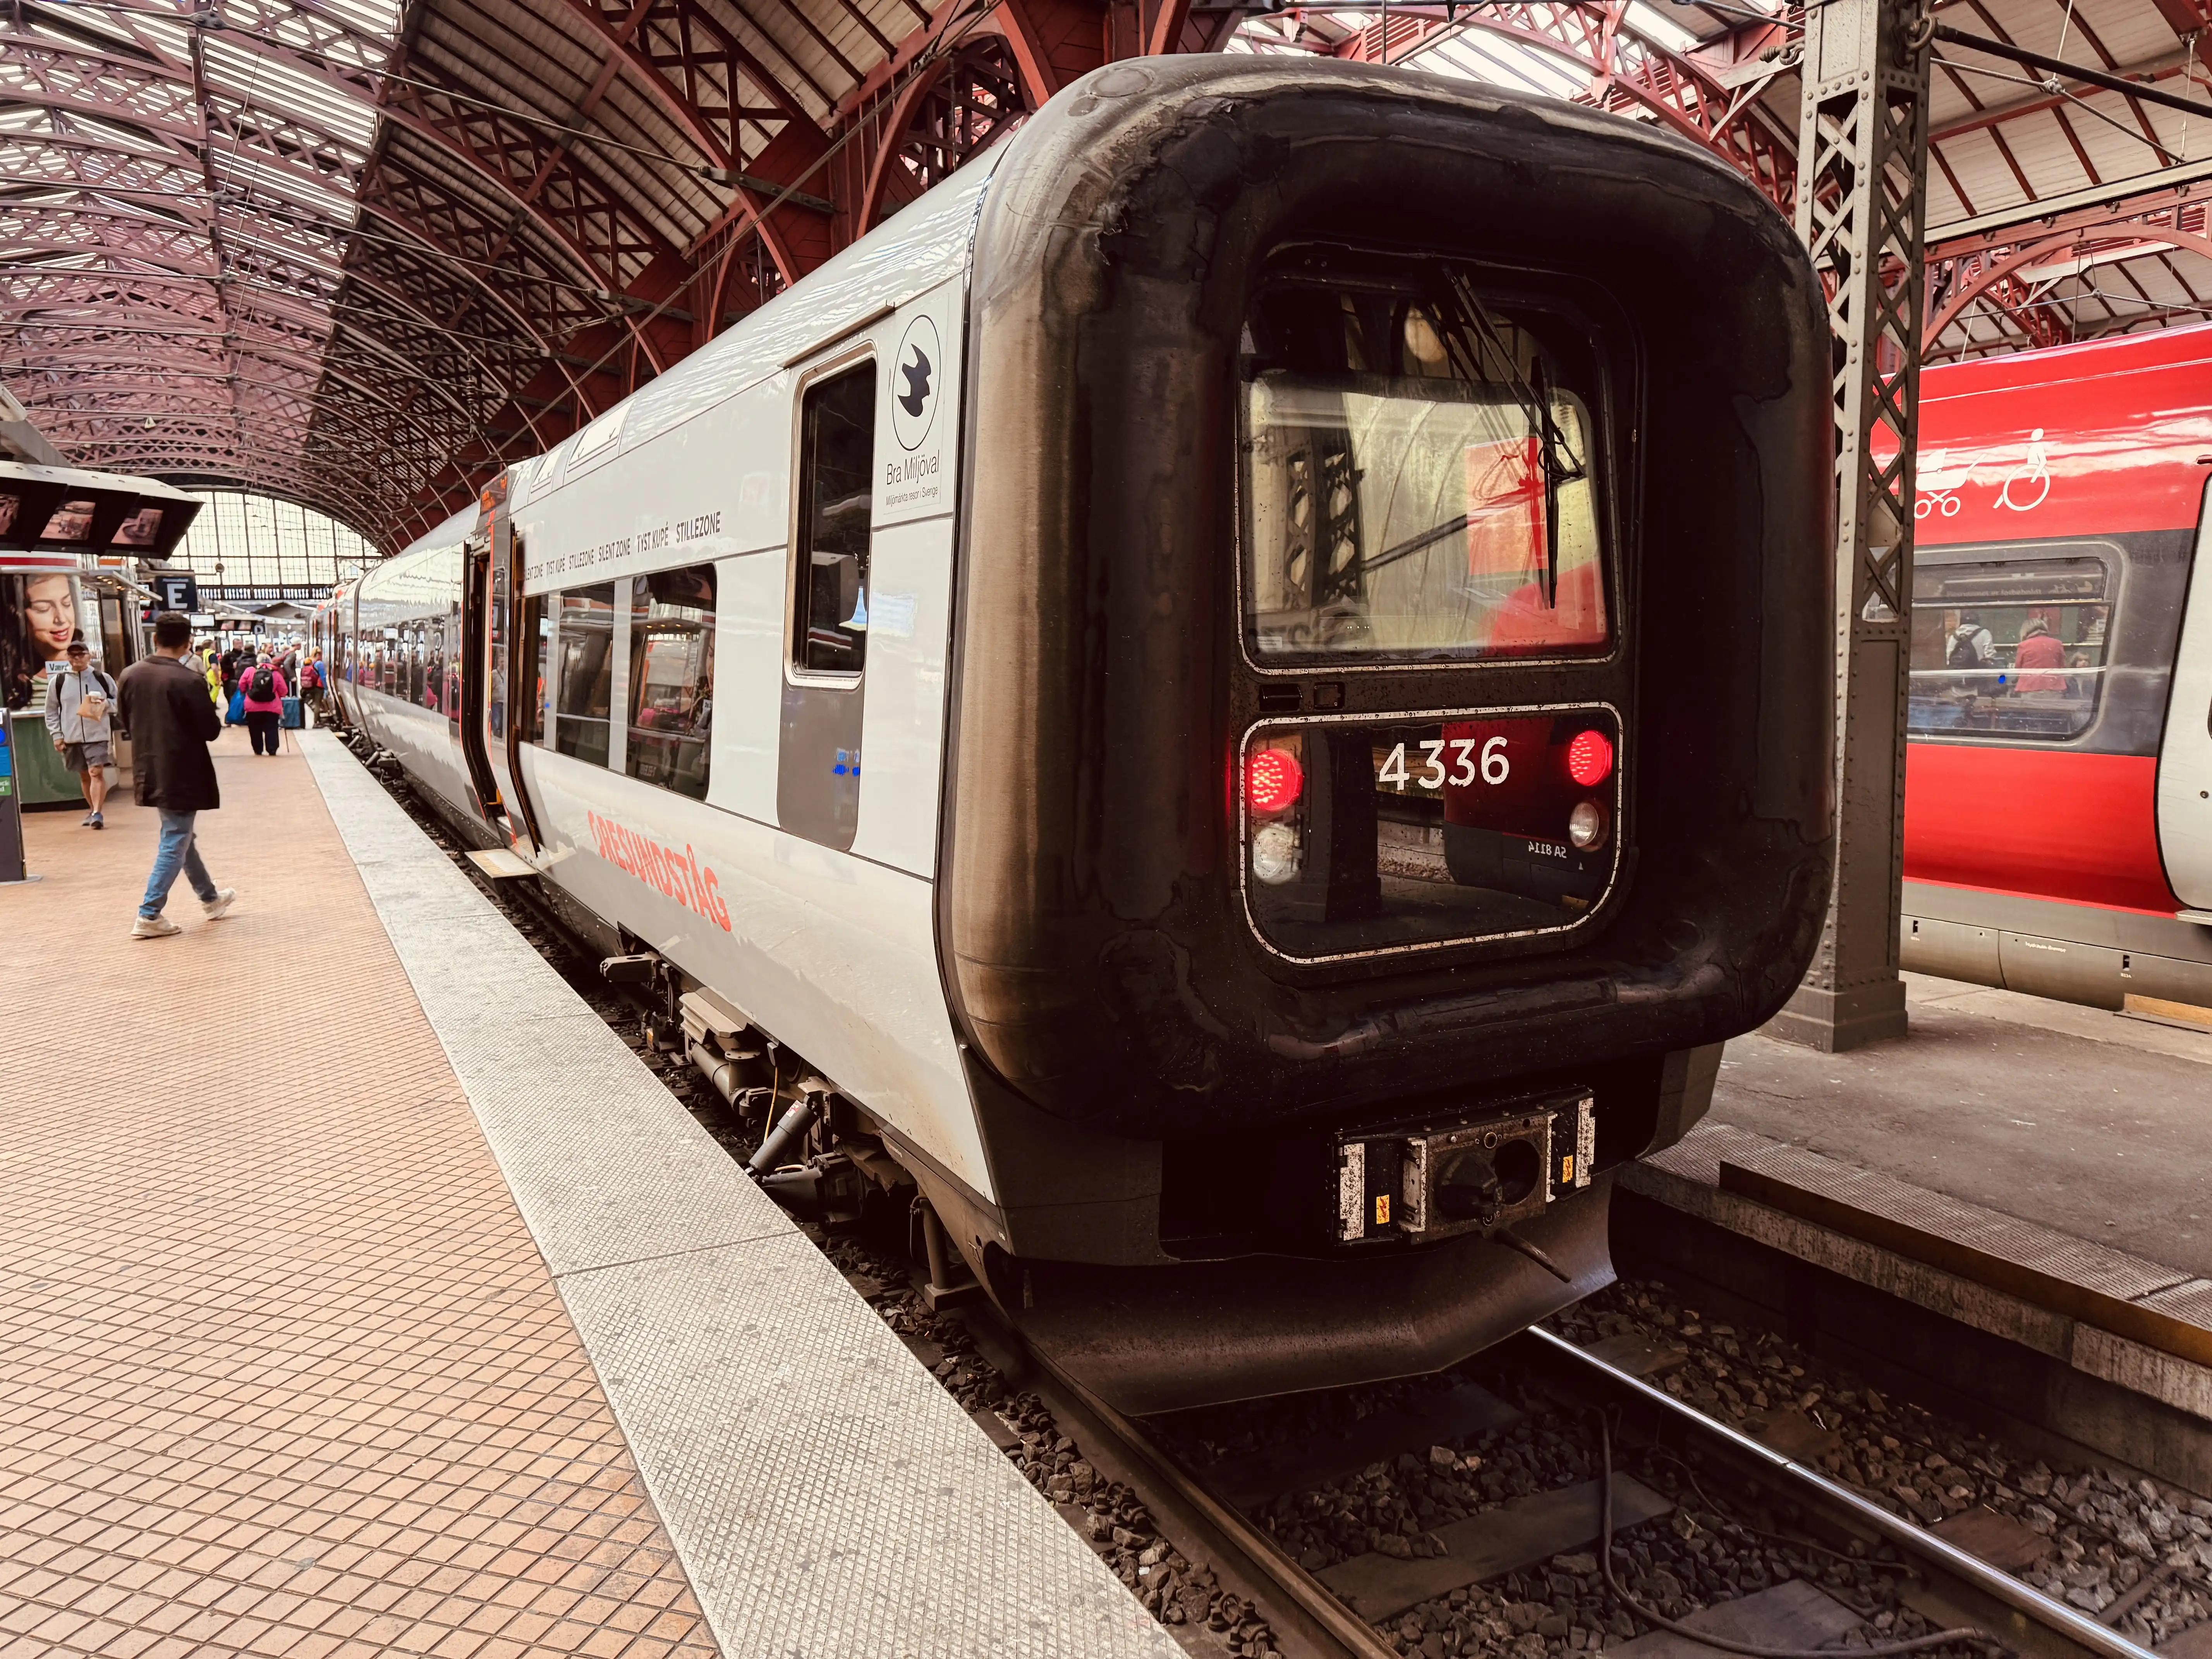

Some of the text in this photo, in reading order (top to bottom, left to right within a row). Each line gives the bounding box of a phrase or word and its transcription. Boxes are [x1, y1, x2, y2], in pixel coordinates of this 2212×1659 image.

[887, 449, 939, 485] Bra Miljöval
[886, 493, 908, 507] Miljömärkta
[908, 490, 919, 501] resor
[922, 485, 938, 498] Sverige
[525, 511, 721, 581] LENT ZONE TYST KUPÉ STILLEZONE SILENT ZONE TYST KUPÉ STILLEZONE
[167, 583, 188, 609] E
[254, 624, 264, 634] D
[1379, 736, 1510, 791] 4336
